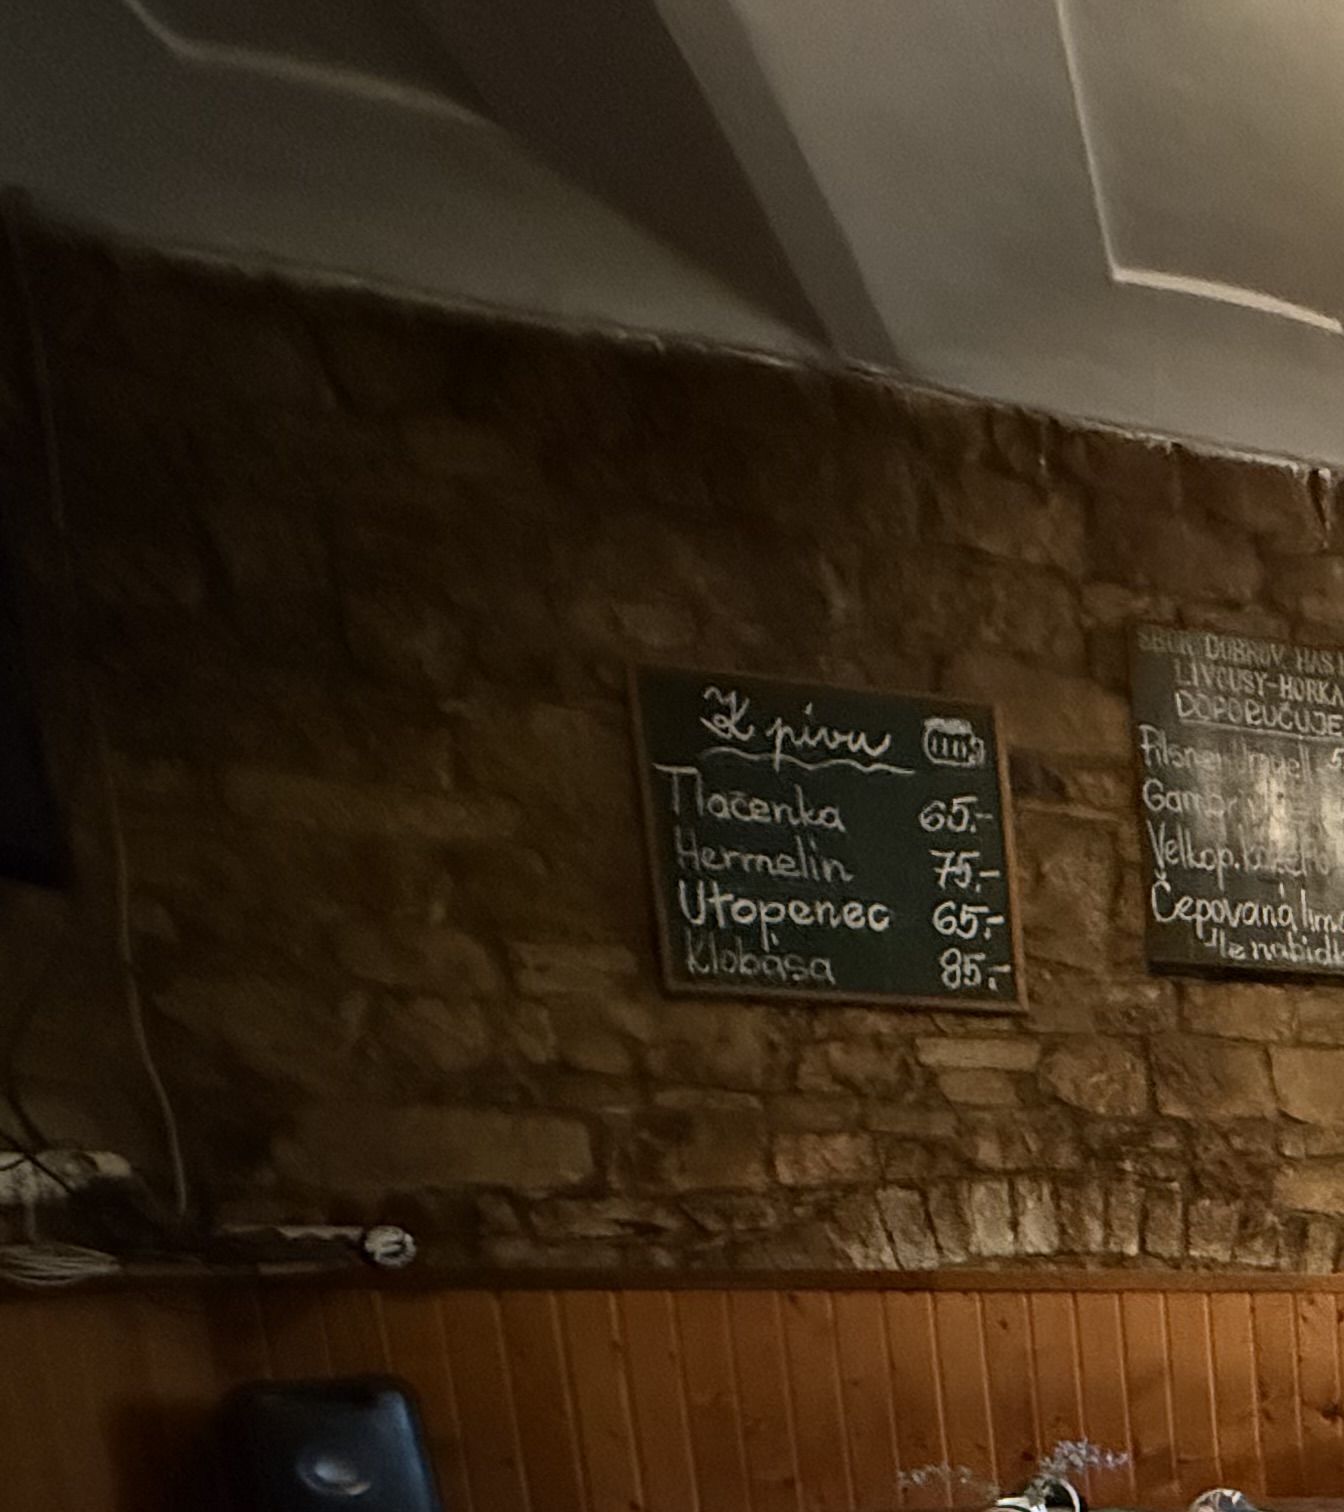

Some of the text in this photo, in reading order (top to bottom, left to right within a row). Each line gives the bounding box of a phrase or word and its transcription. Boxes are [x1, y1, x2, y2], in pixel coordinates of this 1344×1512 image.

[701, 686, 892, 774] K pivu
[1174, 689, 1344, 738] DOPORUČUJE
[652, 762, 848, 833] Tlačenka
[679, 879, 891, 953] Utopenec
[1151, 868, 1298, 941] Čepovaná
